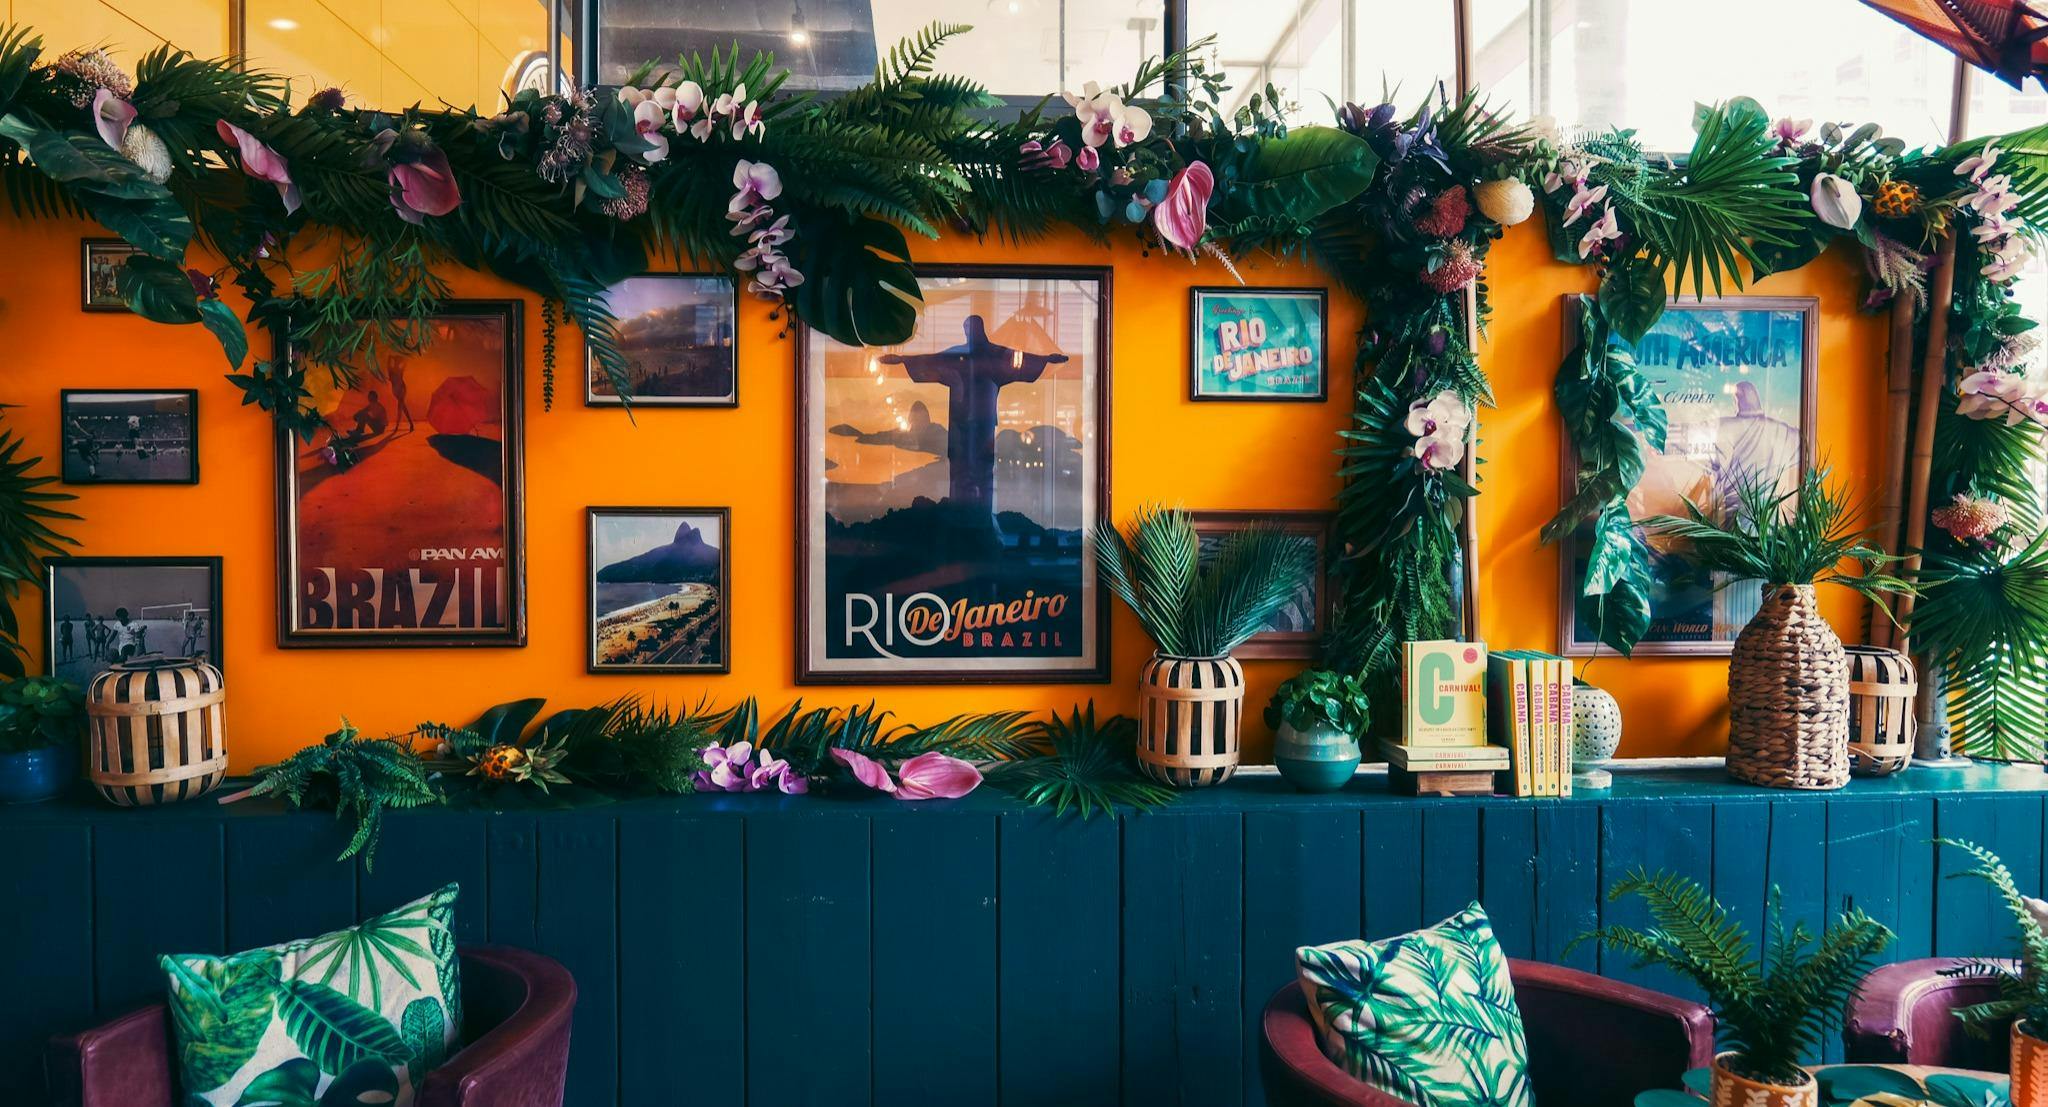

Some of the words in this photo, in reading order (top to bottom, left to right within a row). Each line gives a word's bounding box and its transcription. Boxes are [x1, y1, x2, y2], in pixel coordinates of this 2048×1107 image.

[1217, 317, 1266, 351] RIO
[1213, 351, 1233, 375] DE
[1228, 346, 1312, 382] JANEIRO
[1676, 335, 1788, 370] AMERICA
[1663, 390, 1714, 403] CLIPPER
[421, 548, 468, 560] PAN
[469, 547, 504, 560] AM
[302, 567, 504, 629] BRAZIL
[845, 592, 951, 659] RIO
[906, 606, 943, 636] De
[943, 590, 1069, 642] Janeiro
[963, 631, 1062, 648] BRAZIL
[1672, 624, 1708, 633] WORLD
[1439, 684, 1481, 692] CARNIVAL!
[1516, 683, 1526, 724] CABANA
[1534, 683, 1543, 725] CABANA
[1549, 682, 1558, 723] CABANA
[1562, 684, 1571, 725] CABANA
[1435, 761, 1467, 769] CARNIVAL!
